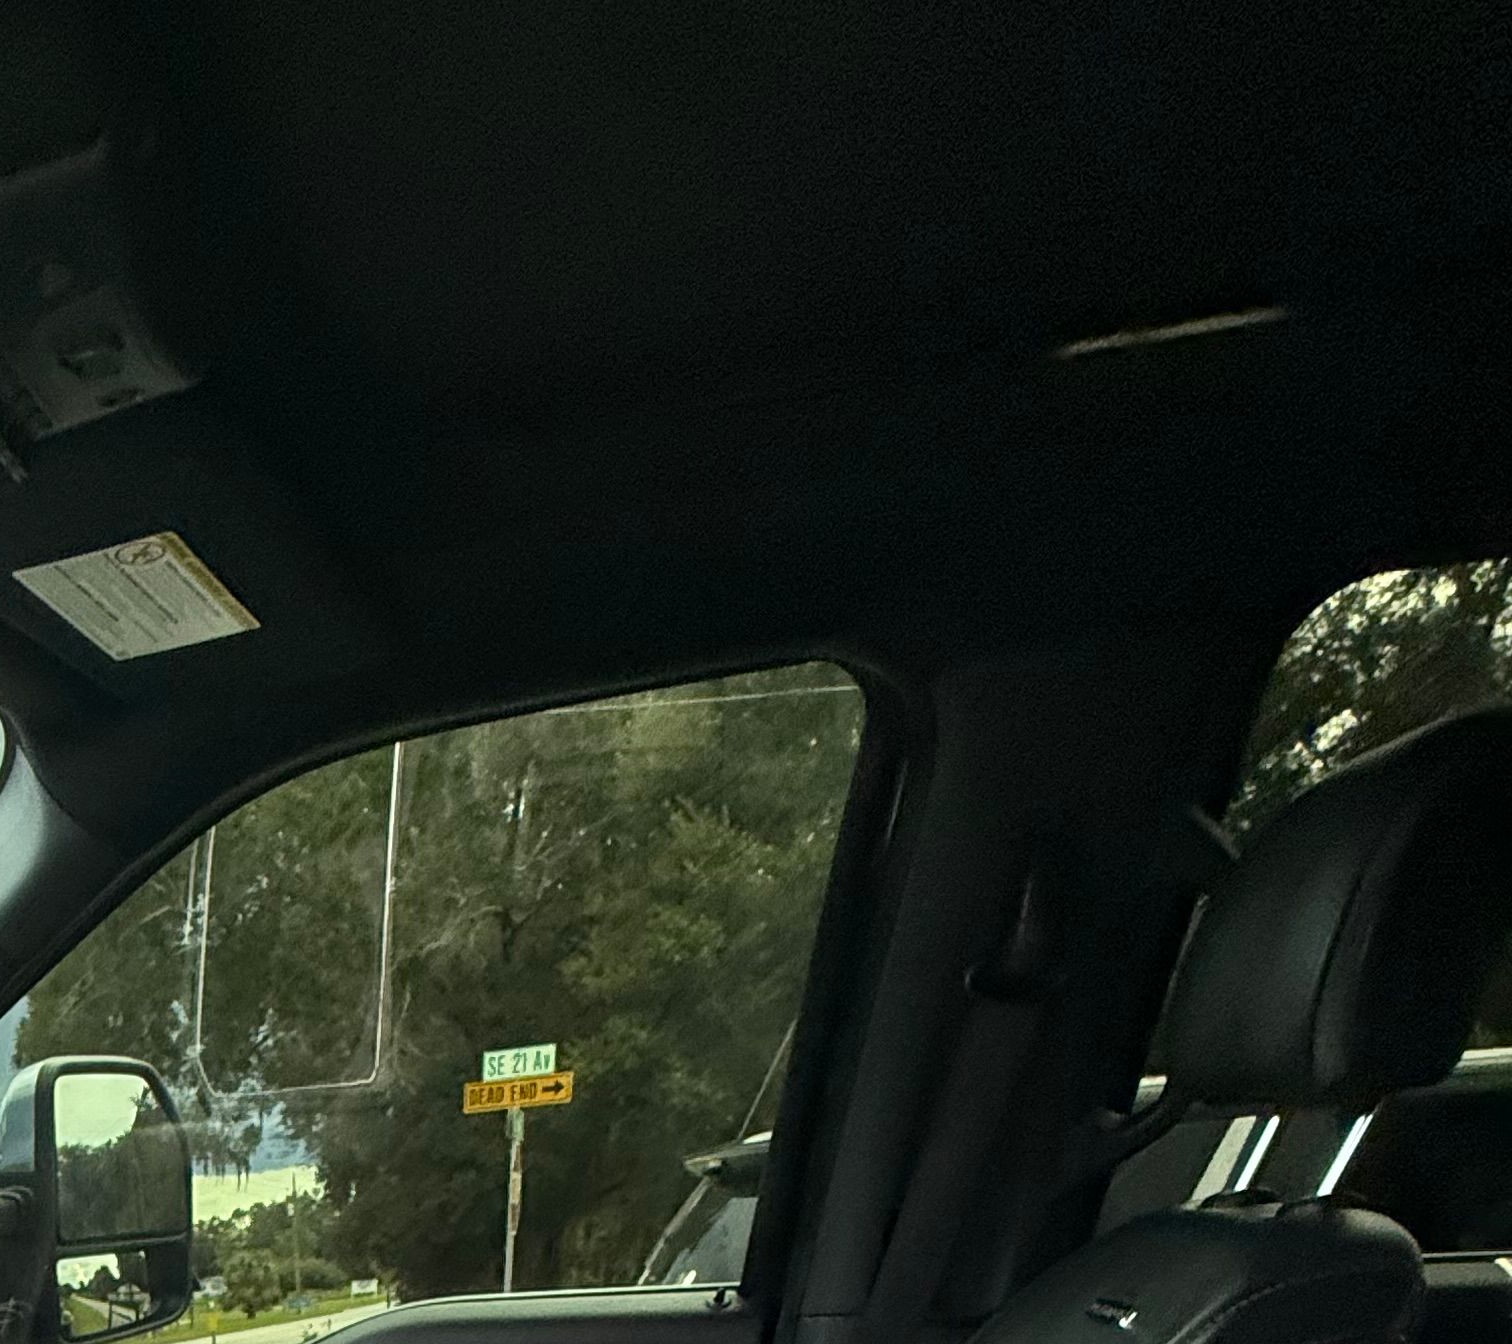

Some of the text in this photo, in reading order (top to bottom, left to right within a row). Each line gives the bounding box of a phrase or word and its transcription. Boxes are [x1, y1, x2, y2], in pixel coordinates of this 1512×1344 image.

[487, 1050, 551, 1077] SE 21 Av
[469, 1082, 538, 1106] DEAD END
